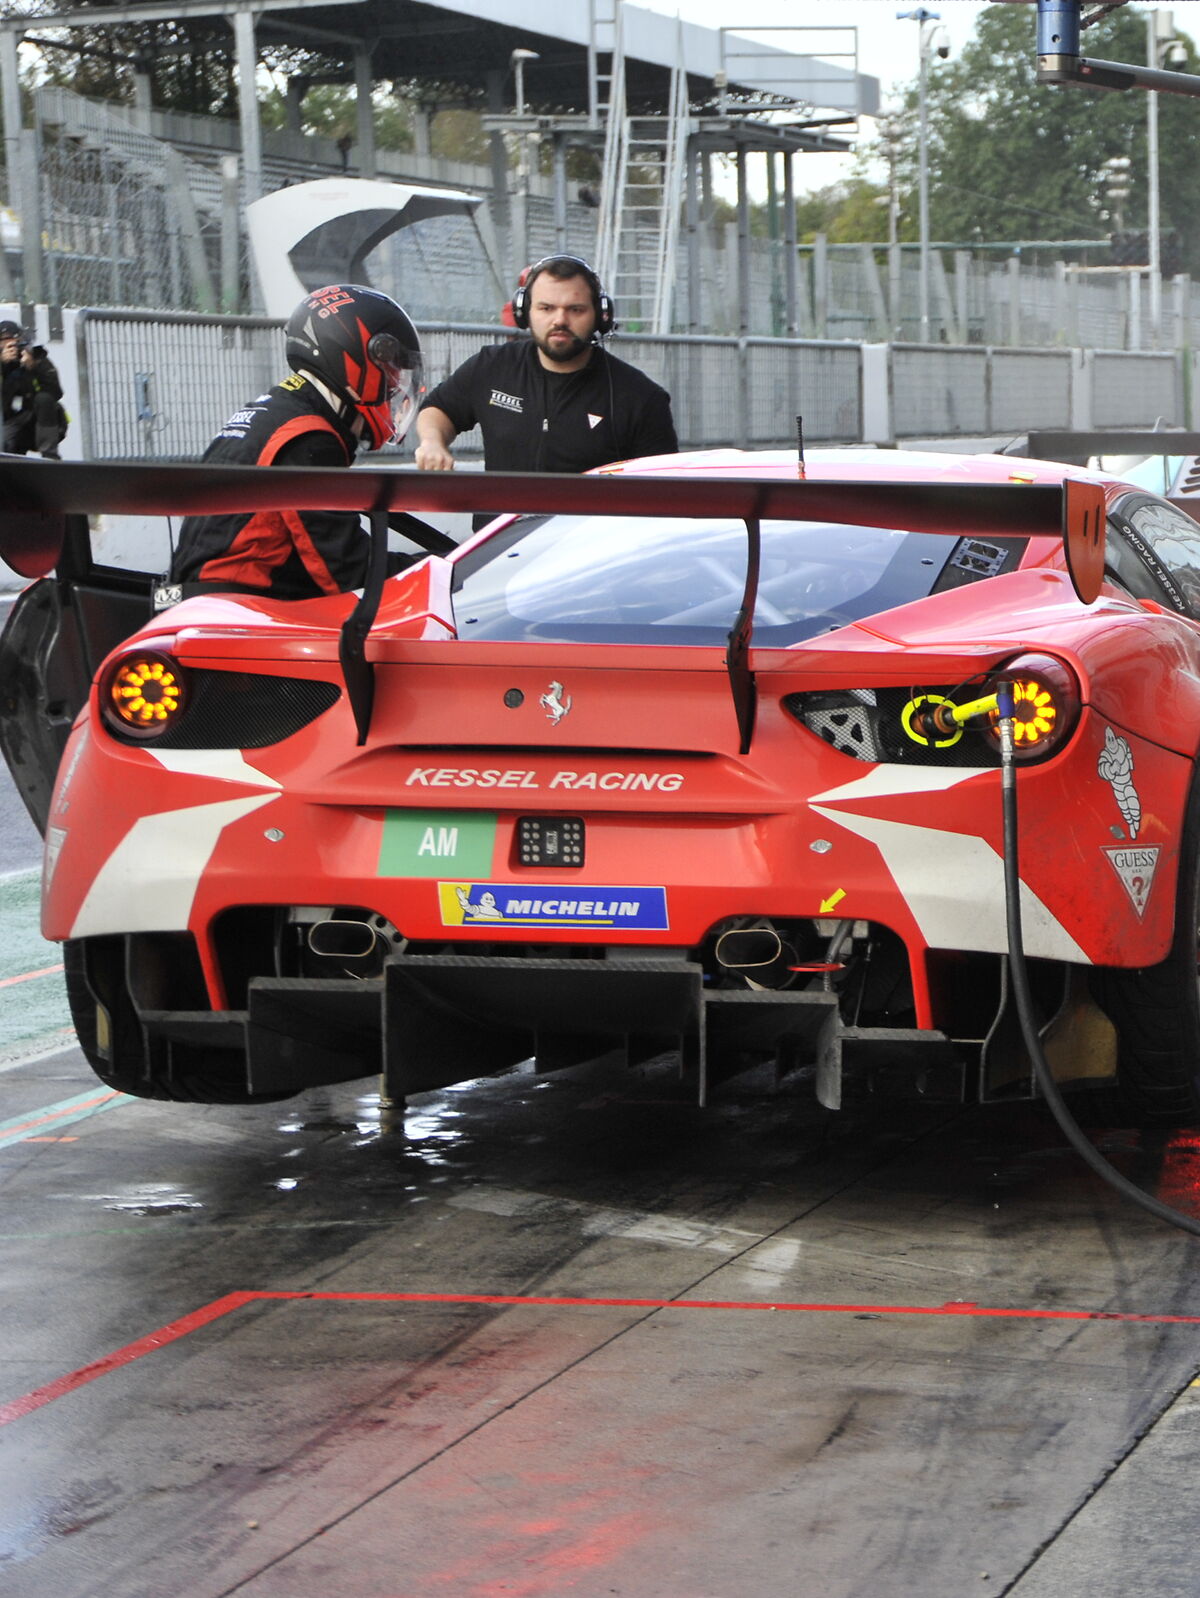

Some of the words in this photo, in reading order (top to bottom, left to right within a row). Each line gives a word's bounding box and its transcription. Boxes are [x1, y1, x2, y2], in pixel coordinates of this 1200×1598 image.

[1122, 525, 1157, 566] RACING
[1156, 567, 1186, 611] KESSEL
[405, 768, 540, 788] KESSEL
[549, 771, 685, 791] RACING
[418, 827, 458, 856] AM
[1114, 851, 1155, 868] GUESS
[505, 900, 640, 916] MICHELIN
